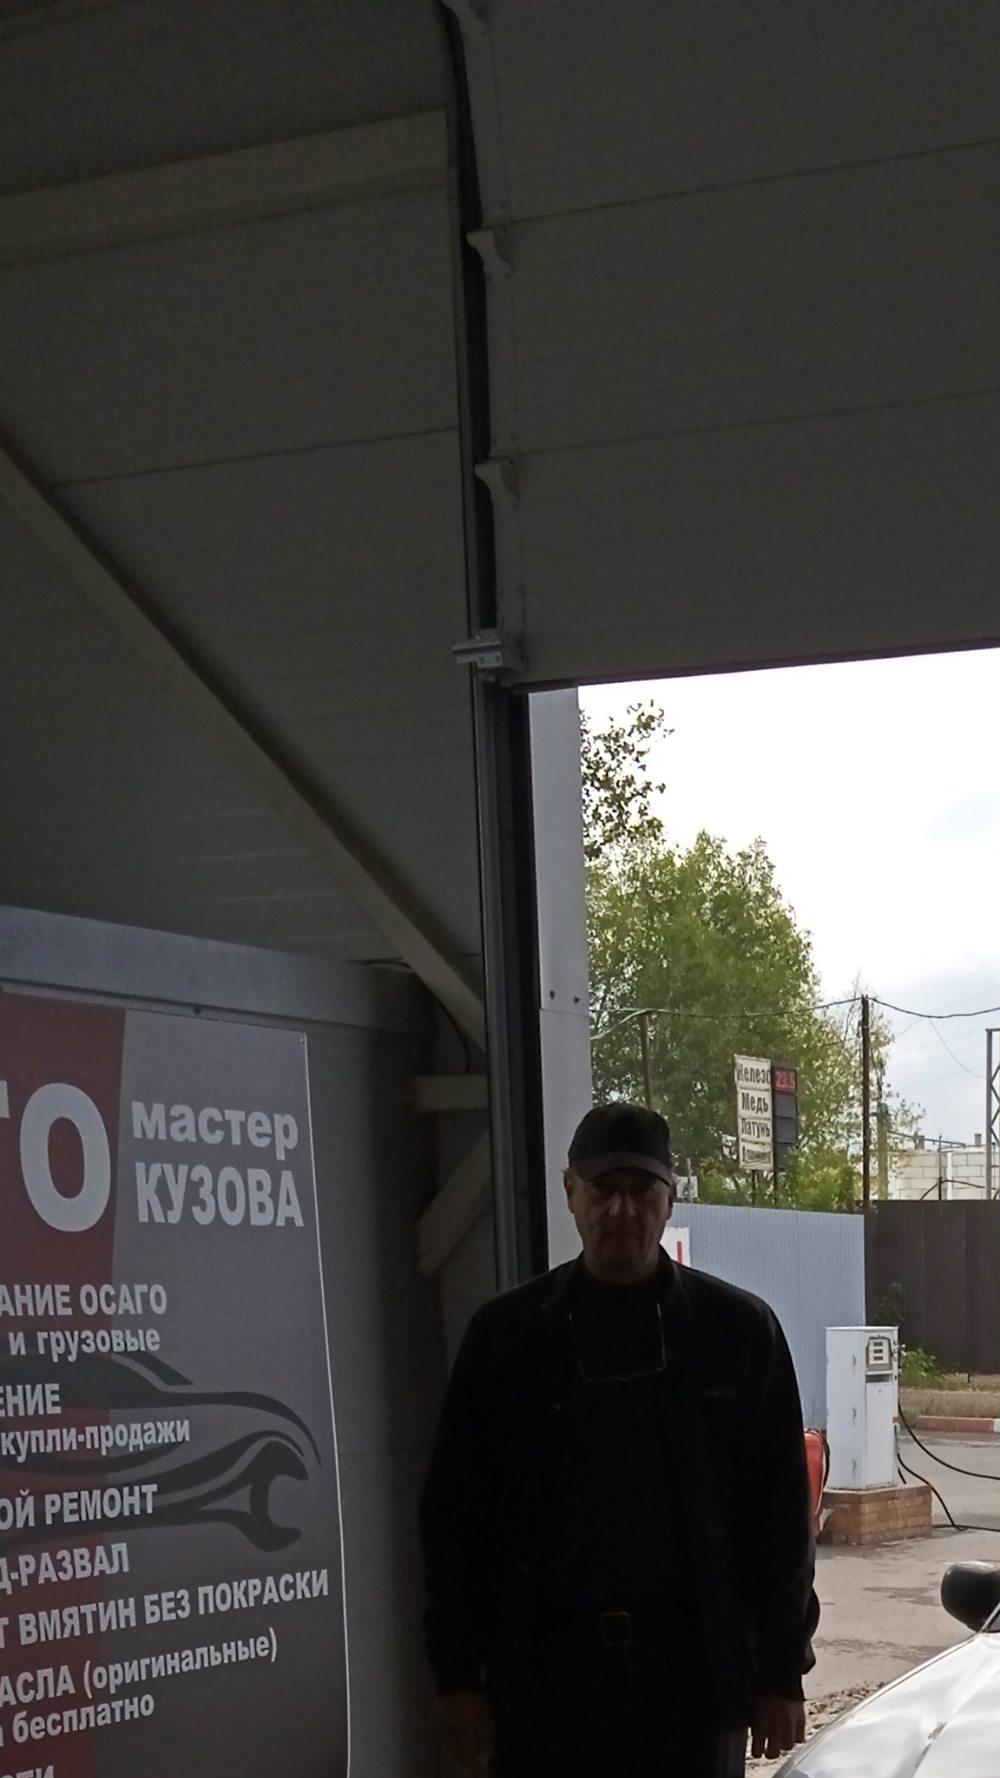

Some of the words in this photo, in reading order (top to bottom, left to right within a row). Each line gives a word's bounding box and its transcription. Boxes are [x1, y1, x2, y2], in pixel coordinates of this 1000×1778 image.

[742, 1092, 769, 1114] Медь
[132, 1101, 299, 1161] мастер
[135, 1162, 304, 1227] КУЗОВА
[80, 1283, 167, 1316] ОСАГО
[9, 1331, 27, 1356] и
[36, 1328, 161, 1363] грузовые
[1, 1419, 190, 1463] купли-продажи
[45, 1484, 158, 1525] РЕМОНТ
[18, 1597, 137, 1646] ВМЯТИН
[143, 1588, 191, 1625] БЕЗ
[198, 1569, 329, 1615] ПОКРАСКИ
[83, 1627, 277, 1699] (оригинальные)
[12, 1694, 155, 1743] бесплатно
